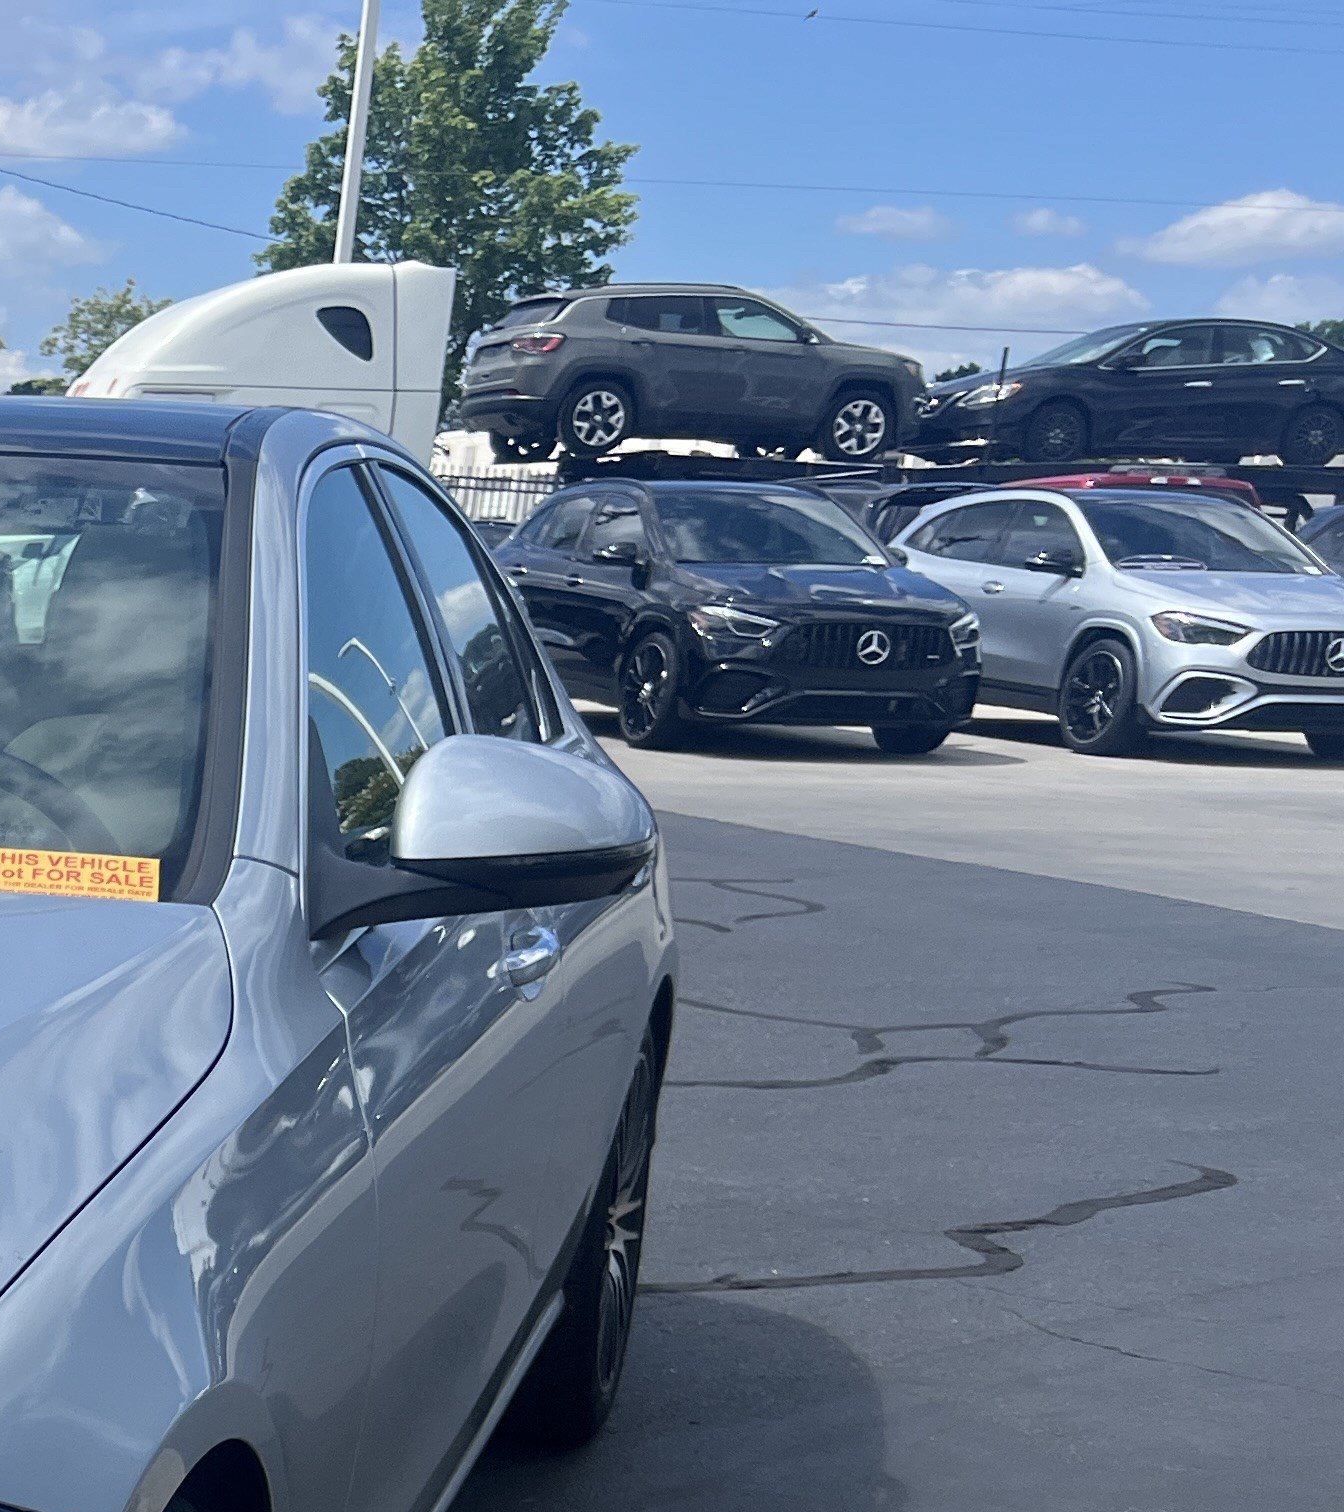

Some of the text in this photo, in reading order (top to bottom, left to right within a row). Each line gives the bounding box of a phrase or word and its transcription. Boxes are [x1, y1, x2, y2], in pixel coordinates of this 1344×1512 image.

[48, 854, 151, 873] VEHICLE
[32, 868, 81, 882] FOR
[90, 871, 153, 888] SALE
[127, 889, 152, 897] DATE
